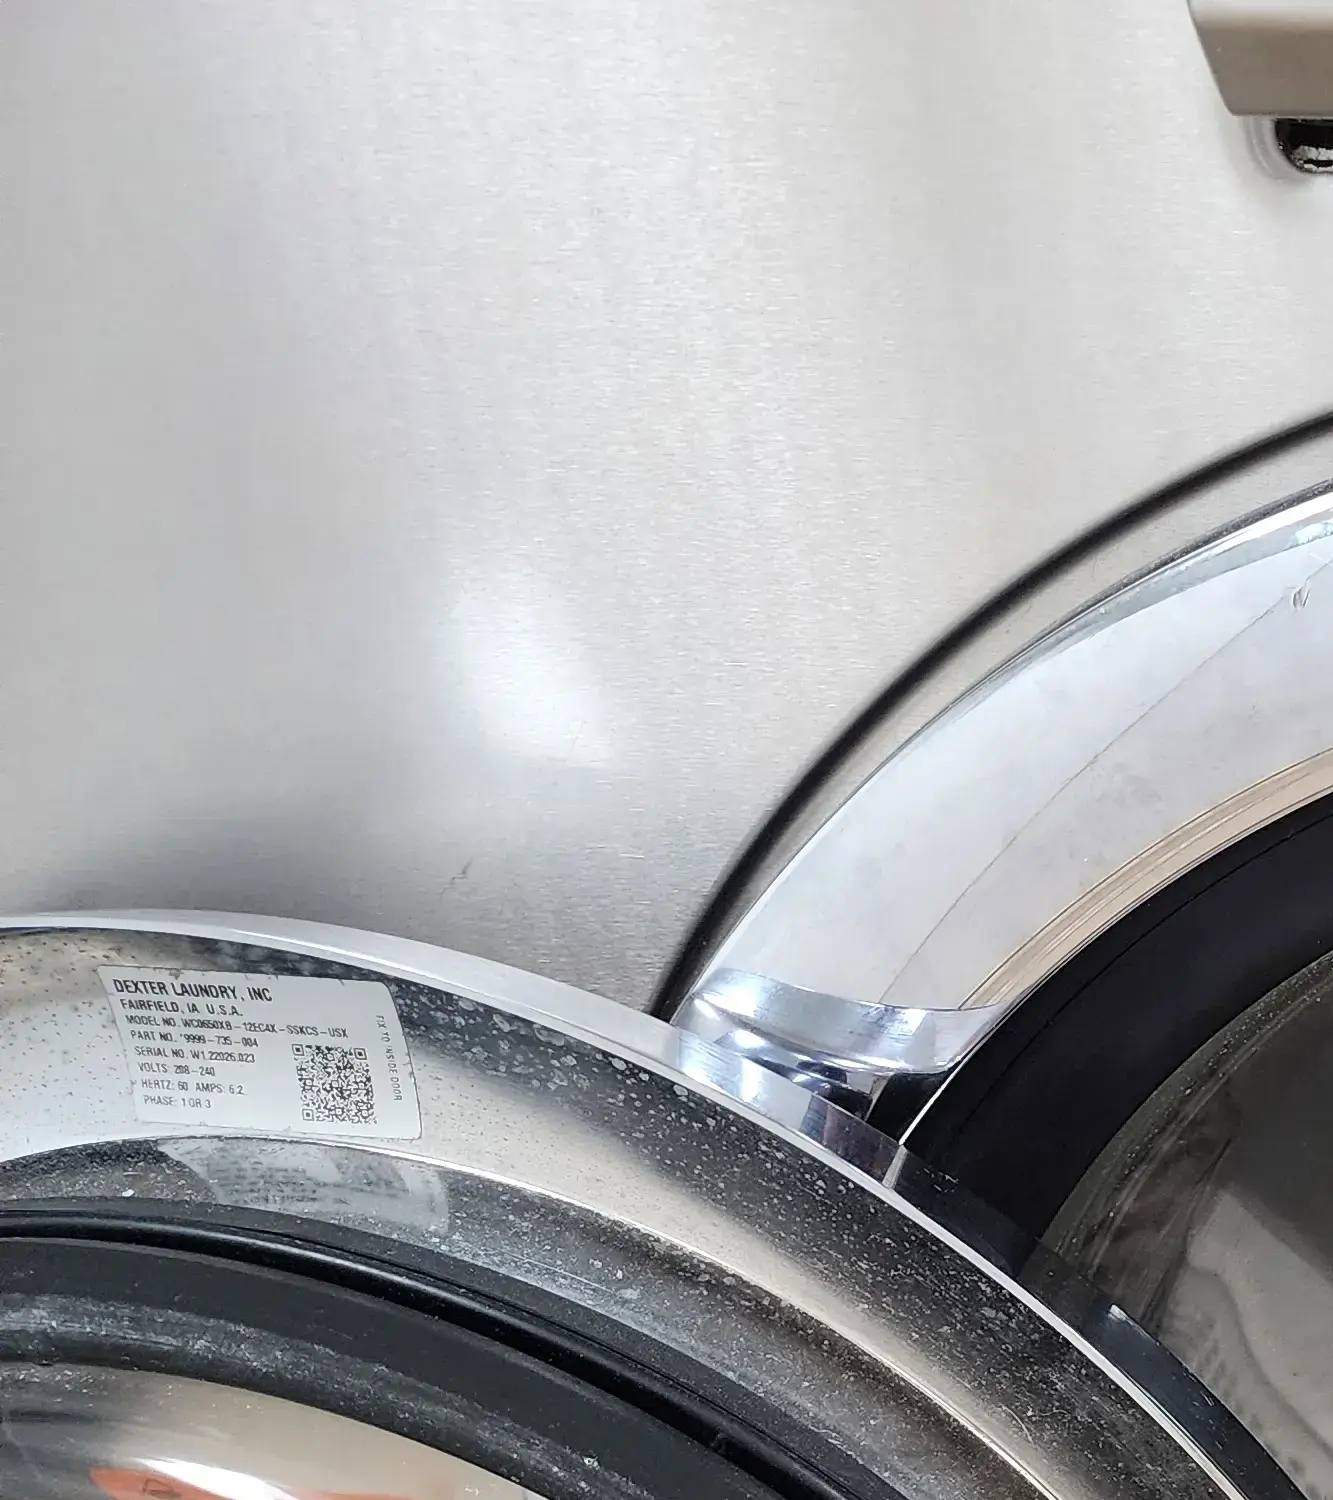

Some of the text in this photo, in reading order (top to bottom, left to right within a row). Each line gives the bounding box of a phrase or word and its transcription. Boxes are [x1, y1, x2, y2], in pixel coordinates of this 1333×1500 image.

[113, 979, 169, 995] DEXTER
[247, 987, 273, 1001] INC
[120, 999, 244, 1016] FAIRFIELD, IA U.S.A.
[125, 1015, 160, 1026] MODEL
[162, 1017, 181, 1028] NO.
[130, 1030, 157, 1041] PART
[159, 1033, 178, 1043] NO.
[134, 1046, 169, 1058] SERIAL
[172, 1049, 188, 1059] NO.
[376, 1014, 403, 1101] FIX TO INSIDE DOOR
[177, 1081, 189, 1091] 60
[181, 1097, 186, 1106] 1
[188, 1098, 203, 1108] OR
[205, 1099, 212, 1109] 3
